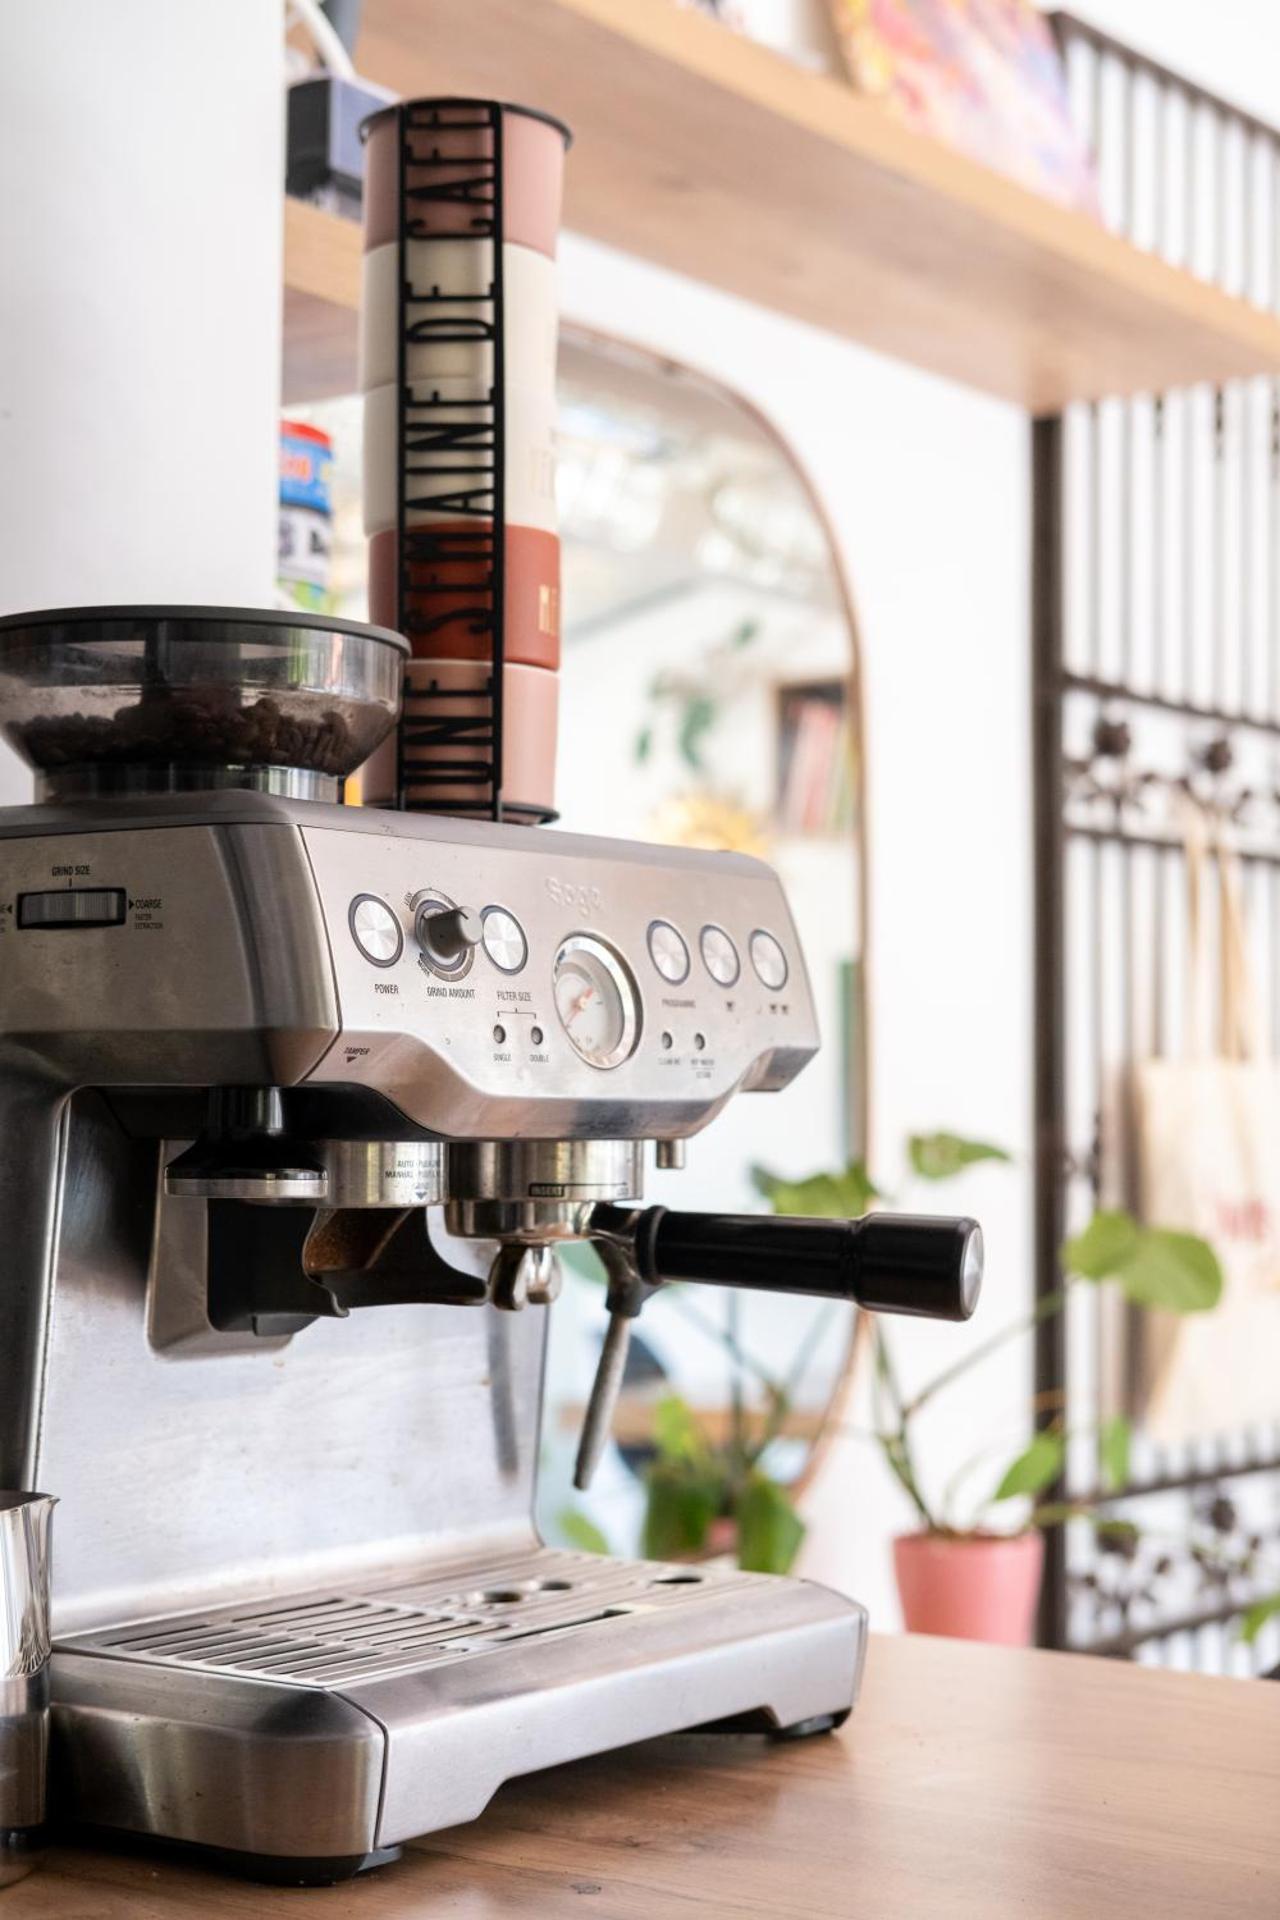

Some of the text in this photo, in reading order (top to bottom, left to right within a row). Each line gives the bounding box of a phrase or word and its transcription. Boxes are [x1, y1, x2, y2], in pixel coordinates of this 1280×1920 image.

[400, 281, 500, 343] DE
[400, 386, 500, 634] SEMAINE
[400, 675, 500, 786] UNE
[51, 864, 91, 876] GRIND SIZE
[374, 983, 399, 994] POWER
[426, 986, 475, 999] GRIND AMOUNT
[496, 990, 517, 1001] FILTER
